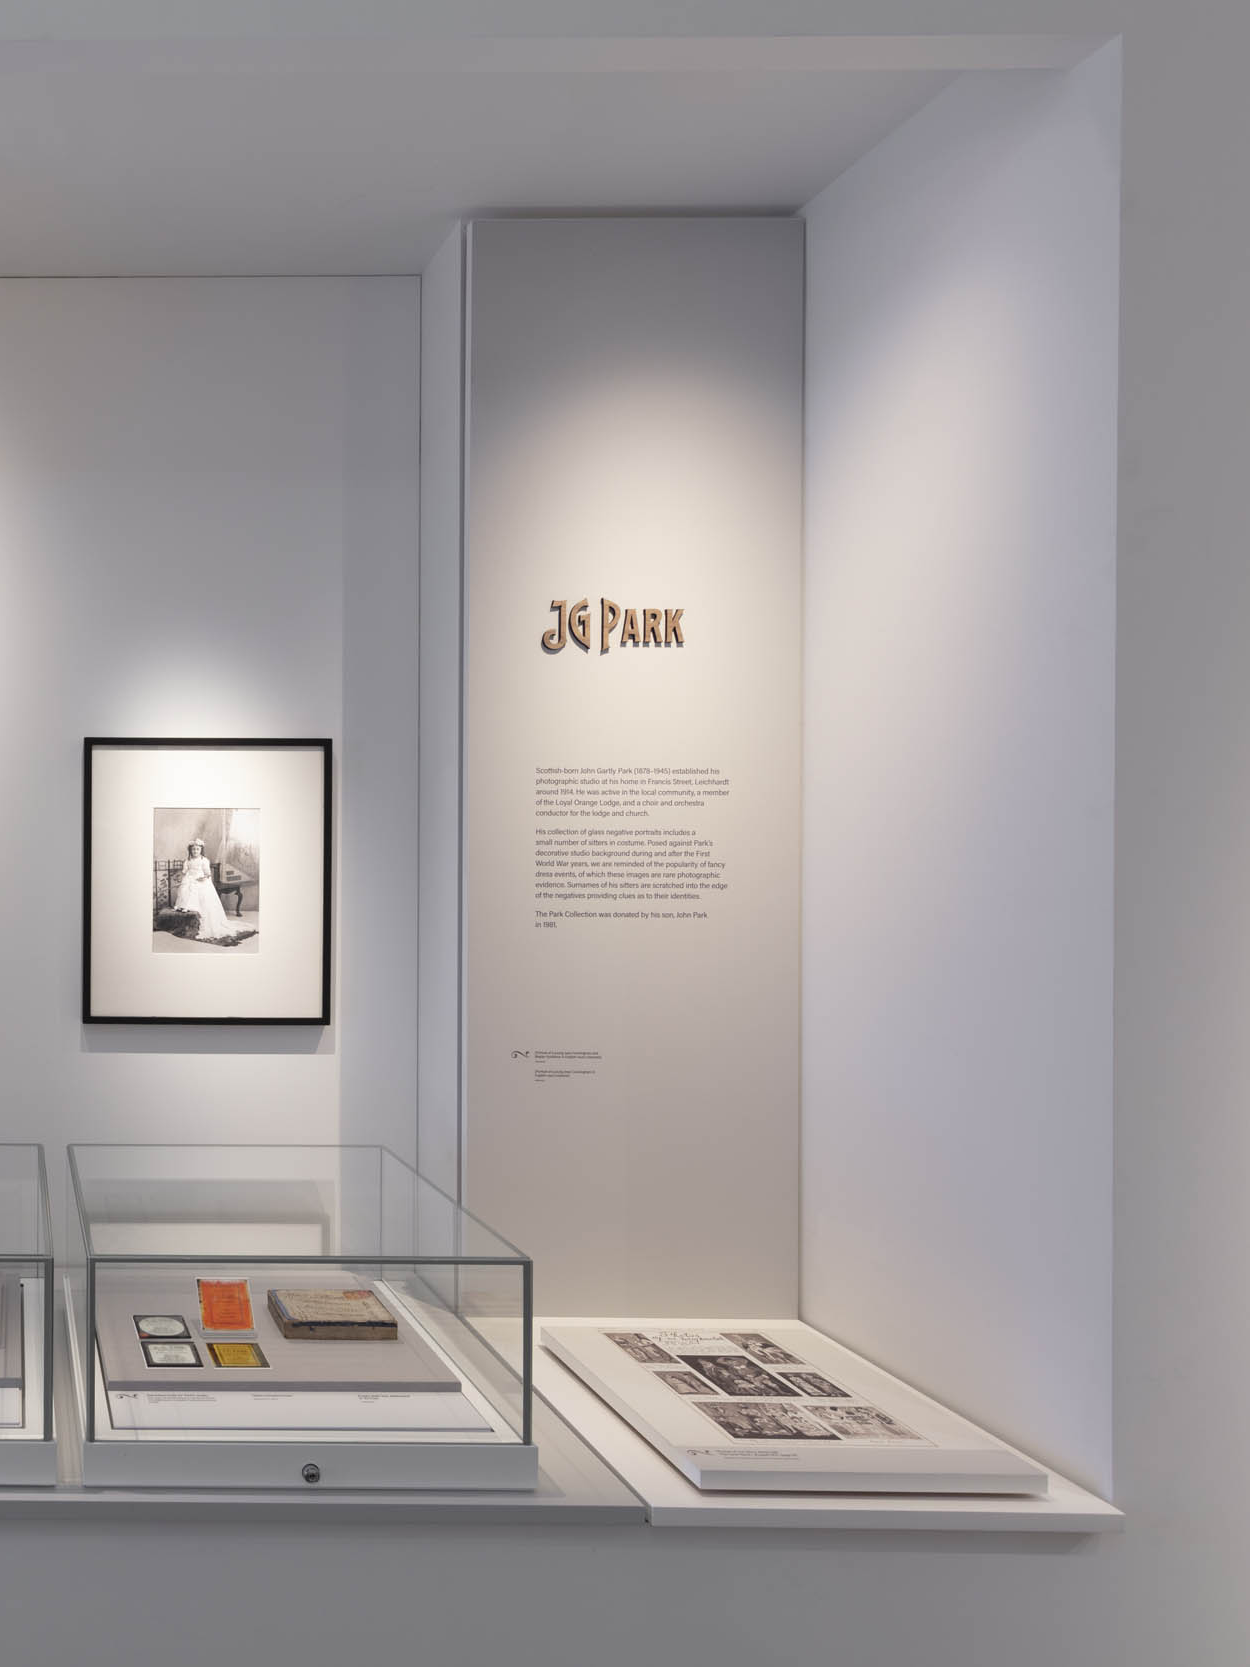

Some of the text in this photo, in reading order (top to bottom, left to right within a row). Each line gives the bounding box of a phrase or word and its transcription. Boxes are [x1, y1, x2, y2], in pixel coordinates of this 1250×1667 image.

[541, 597, 685, 656] JG PARK
[597, 768, 616, 776] Gartly
[535, 778, 578, 786] photographic
[658, 789, 696, 797] community,
[556, 799, 573, 807] Loyal
[574, 799, 598, 807] Orange
[599, 799, 622, 808] Lodge,
[592, 810, 610, 818] lodge
[588, 829, 604, 837] glass
[606, 829, 634, 837] negative
[635, 829, 662, 837] portraits
[669, 840, 692, 848] against
[591, 850, 630, 858] background
[631, 850, 653, 859] during
[665, 861, 698, 869] popularity
[707, 862, 726, 870] fancy
[626, 872, 650, 880] images
[677, 872, 721, 880] photographic
[711, 883, 728, 891] edge
[555, 892, 586, 900] negatives
[587, 893, 617, 901] providing
[641, 911, 649, 920] by
